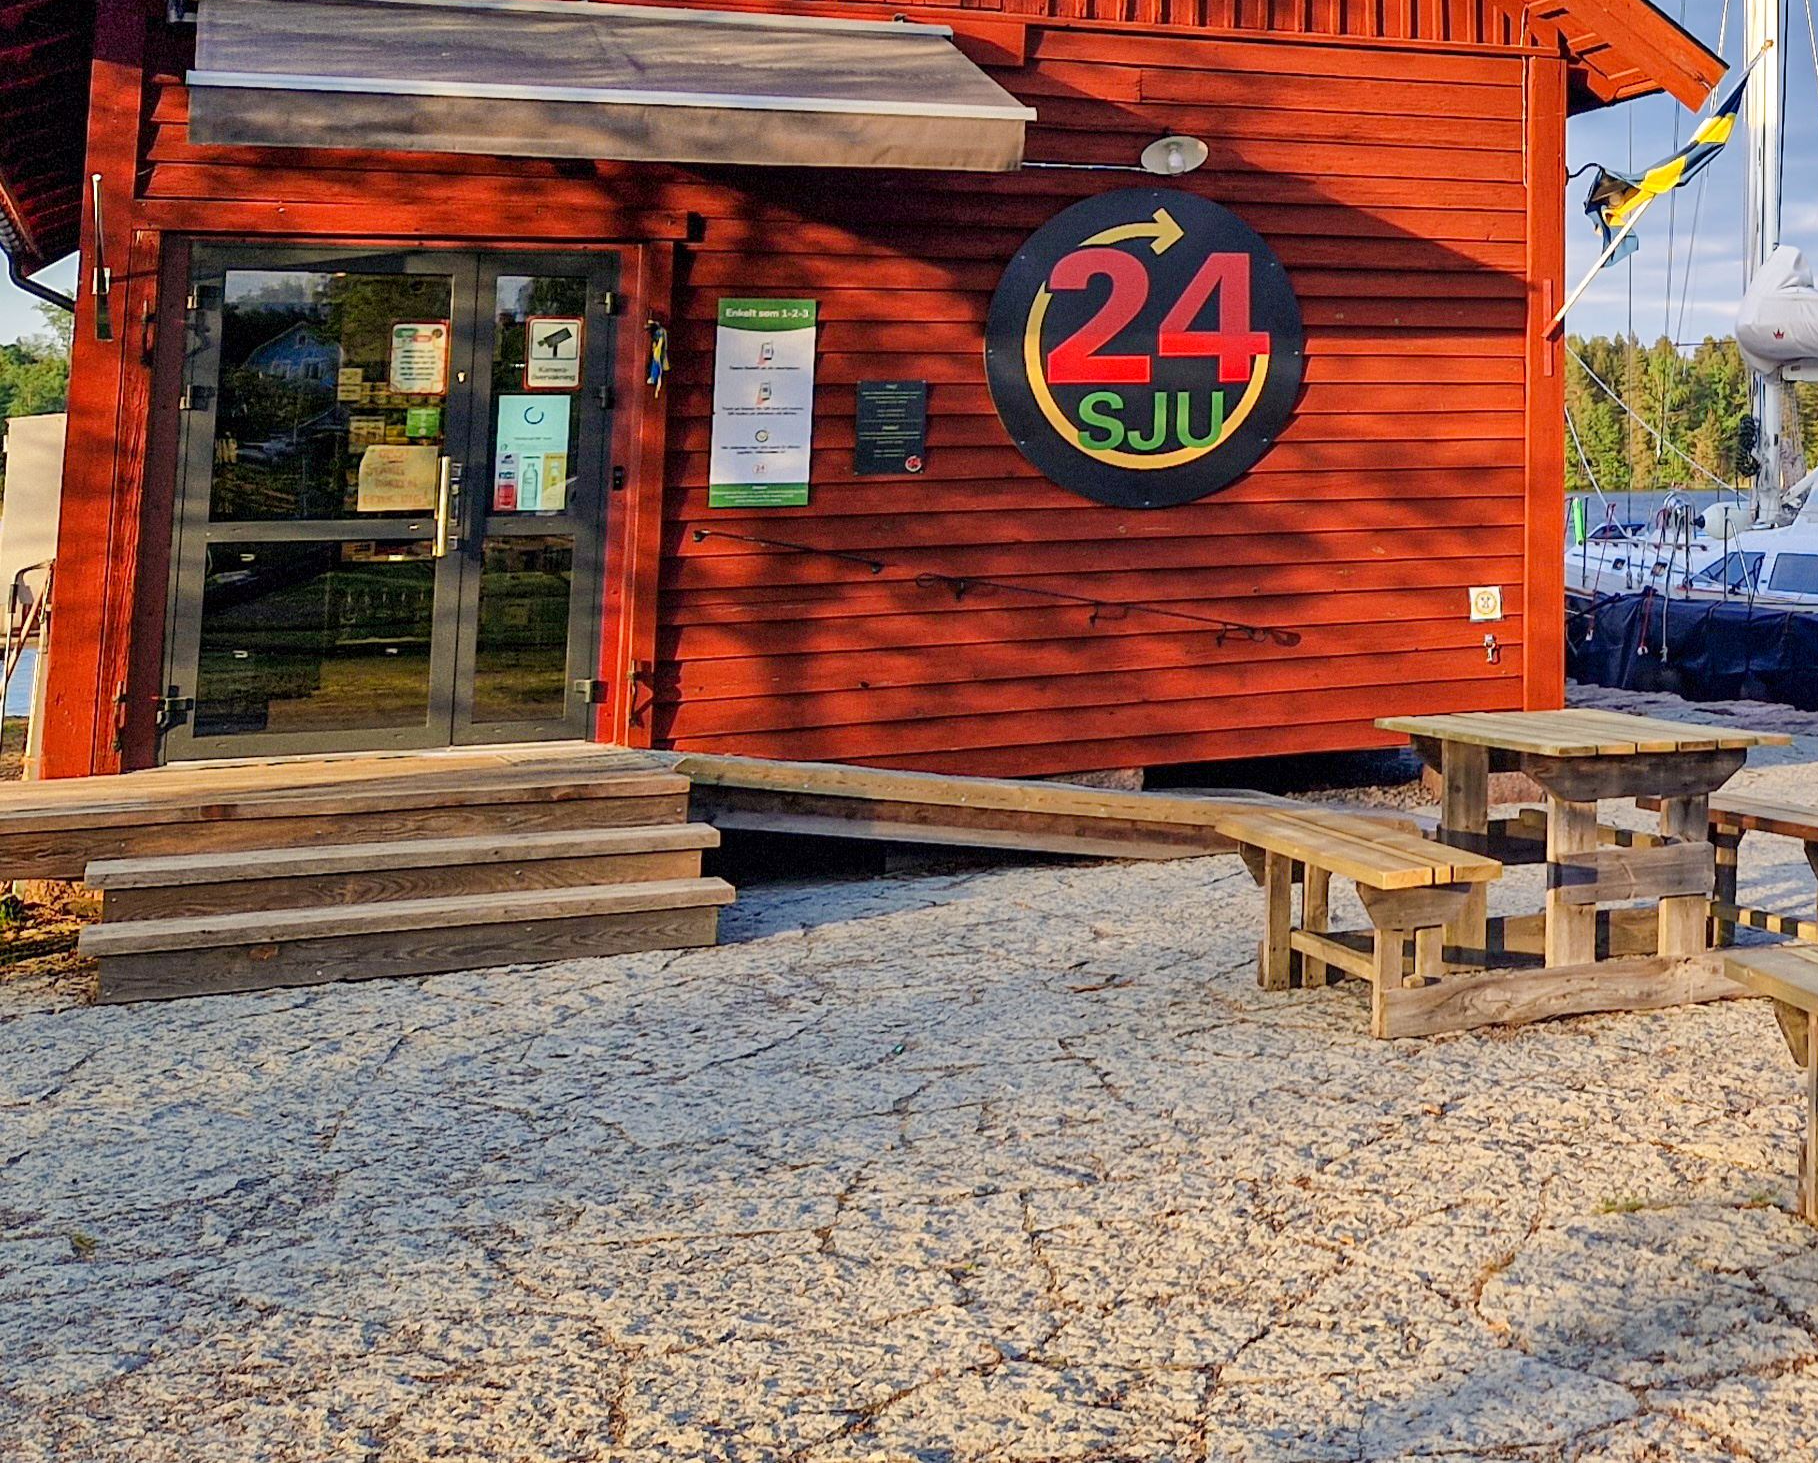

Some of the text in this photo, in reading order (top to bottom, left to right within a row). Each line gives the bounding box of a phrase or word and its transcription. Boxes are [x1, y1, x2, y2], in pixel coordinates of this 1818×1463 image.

[725, 308, 809, 318] Enkelt som 1-2-3
[1047, 247, 1271, 384] 24
[1077, 391, 1226, 451] SJU
